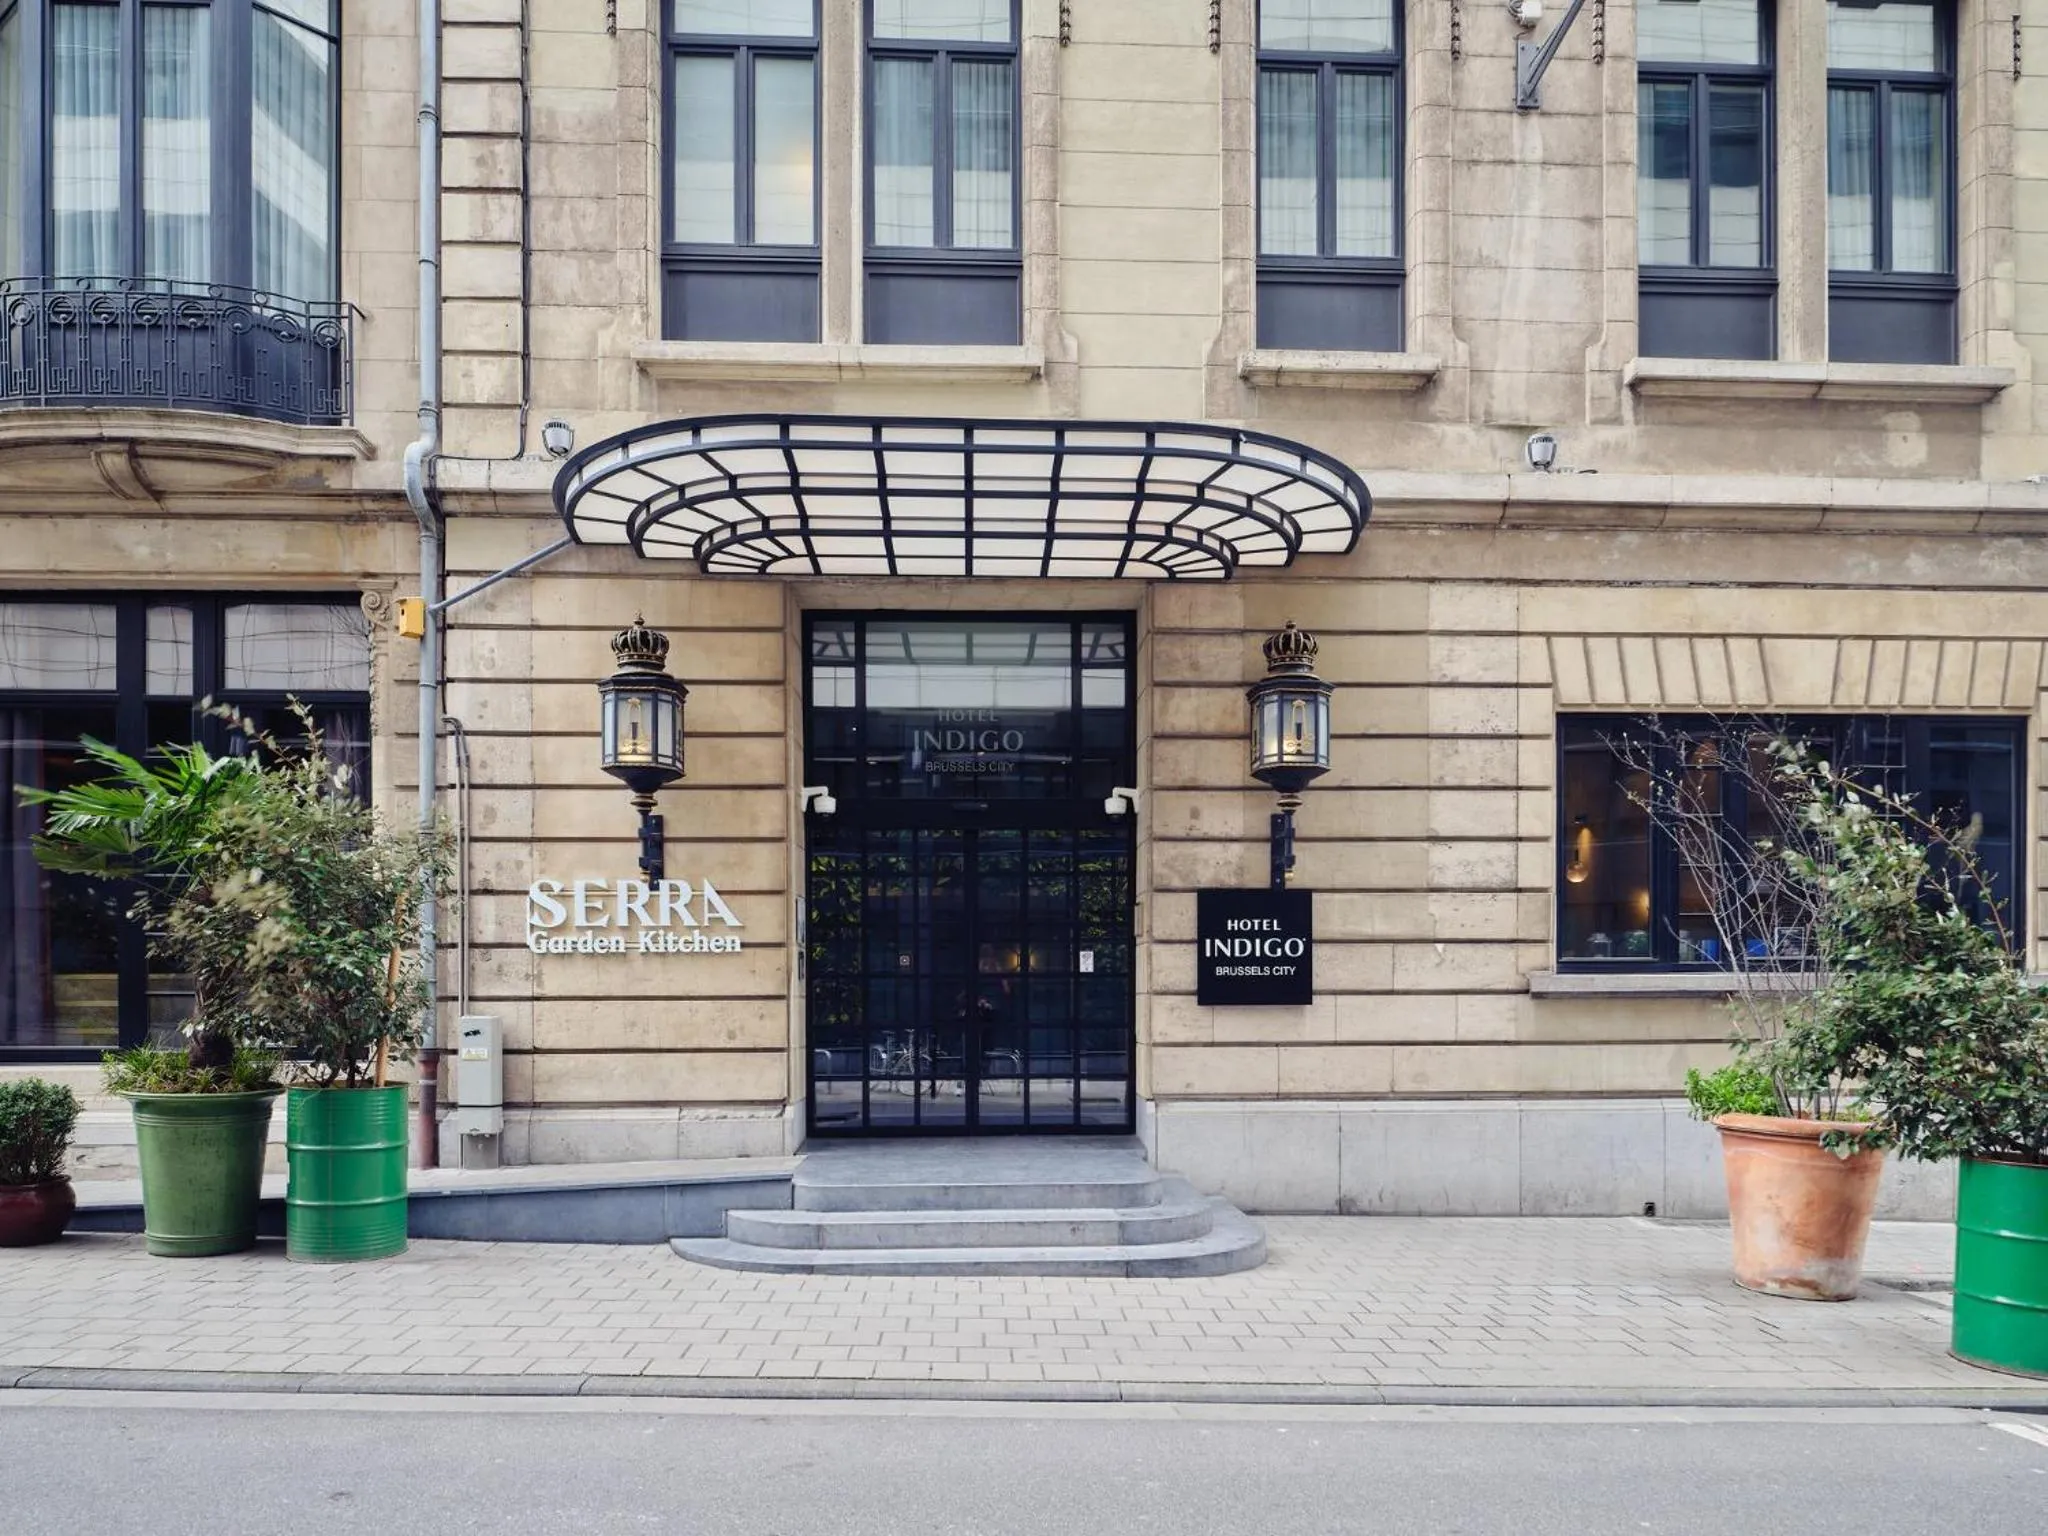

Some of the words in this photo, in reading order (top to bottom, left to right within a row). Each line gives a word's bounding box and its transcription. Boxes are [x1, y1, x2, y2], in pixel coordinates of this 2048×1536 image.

[939, 709, 999, 722] HOTEL
[913, 730, 1024, 752] INDIGO
[925, 761, 987, 773] BRUSSELS
[988, 761, 1016, 773] CITY
[528, 878, 744, 928] SERRA
[1226, 918, 1282, 931] HOTEL
[529, 930, 627, 954] Garden
[638, 929, 742, 953] Kitchen
[1204, 937, 1305, 958] INDIGO
[1215, 966, 1271, 976] BRUSSELS
[1272, 966, 1297, 976] CITY
